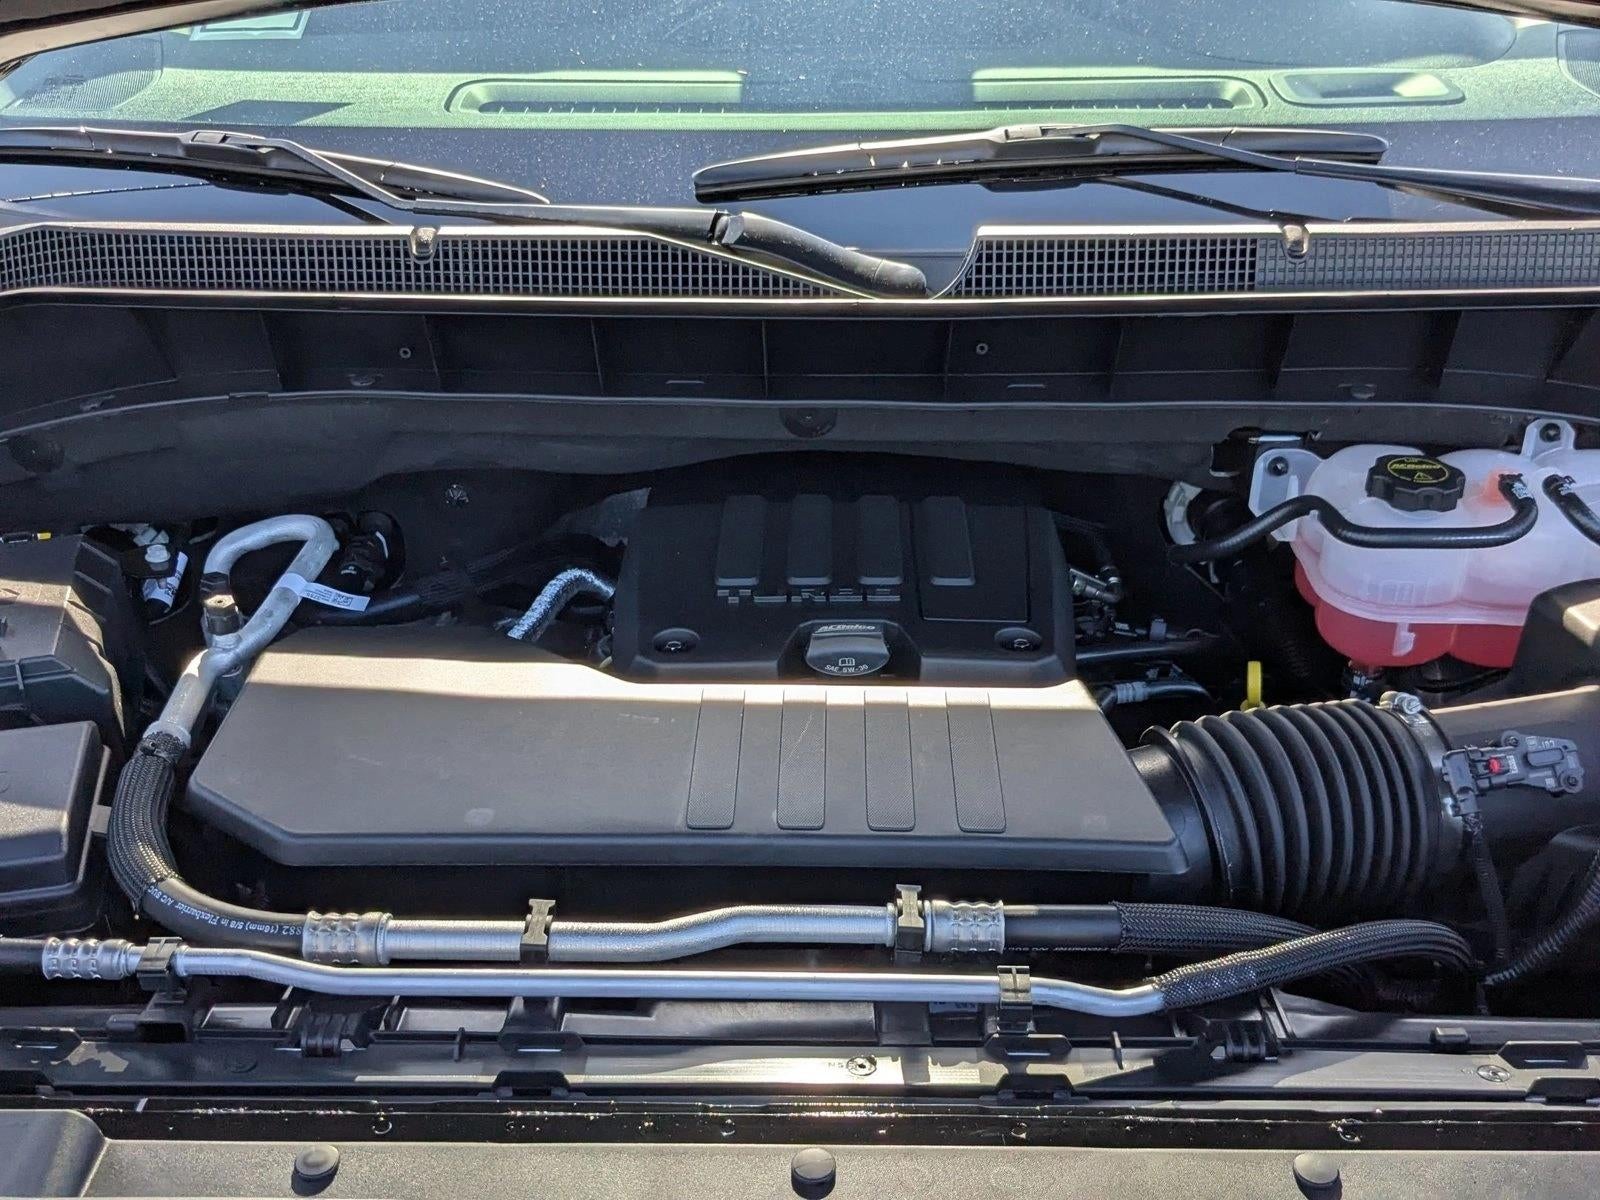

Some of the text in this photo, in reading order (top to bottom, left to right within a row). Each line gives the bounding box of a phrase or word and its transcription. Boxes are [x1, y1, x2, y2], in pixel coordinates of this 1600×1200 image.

[824, 664, 869, 673] SAE 5W-30
[160, 895, 175, 906] A/C
[174, 902, 220, 926] Flexbarrier
[229, 920, 245, 930] 5/8
[245, 921, 279, 934] (16mm)
